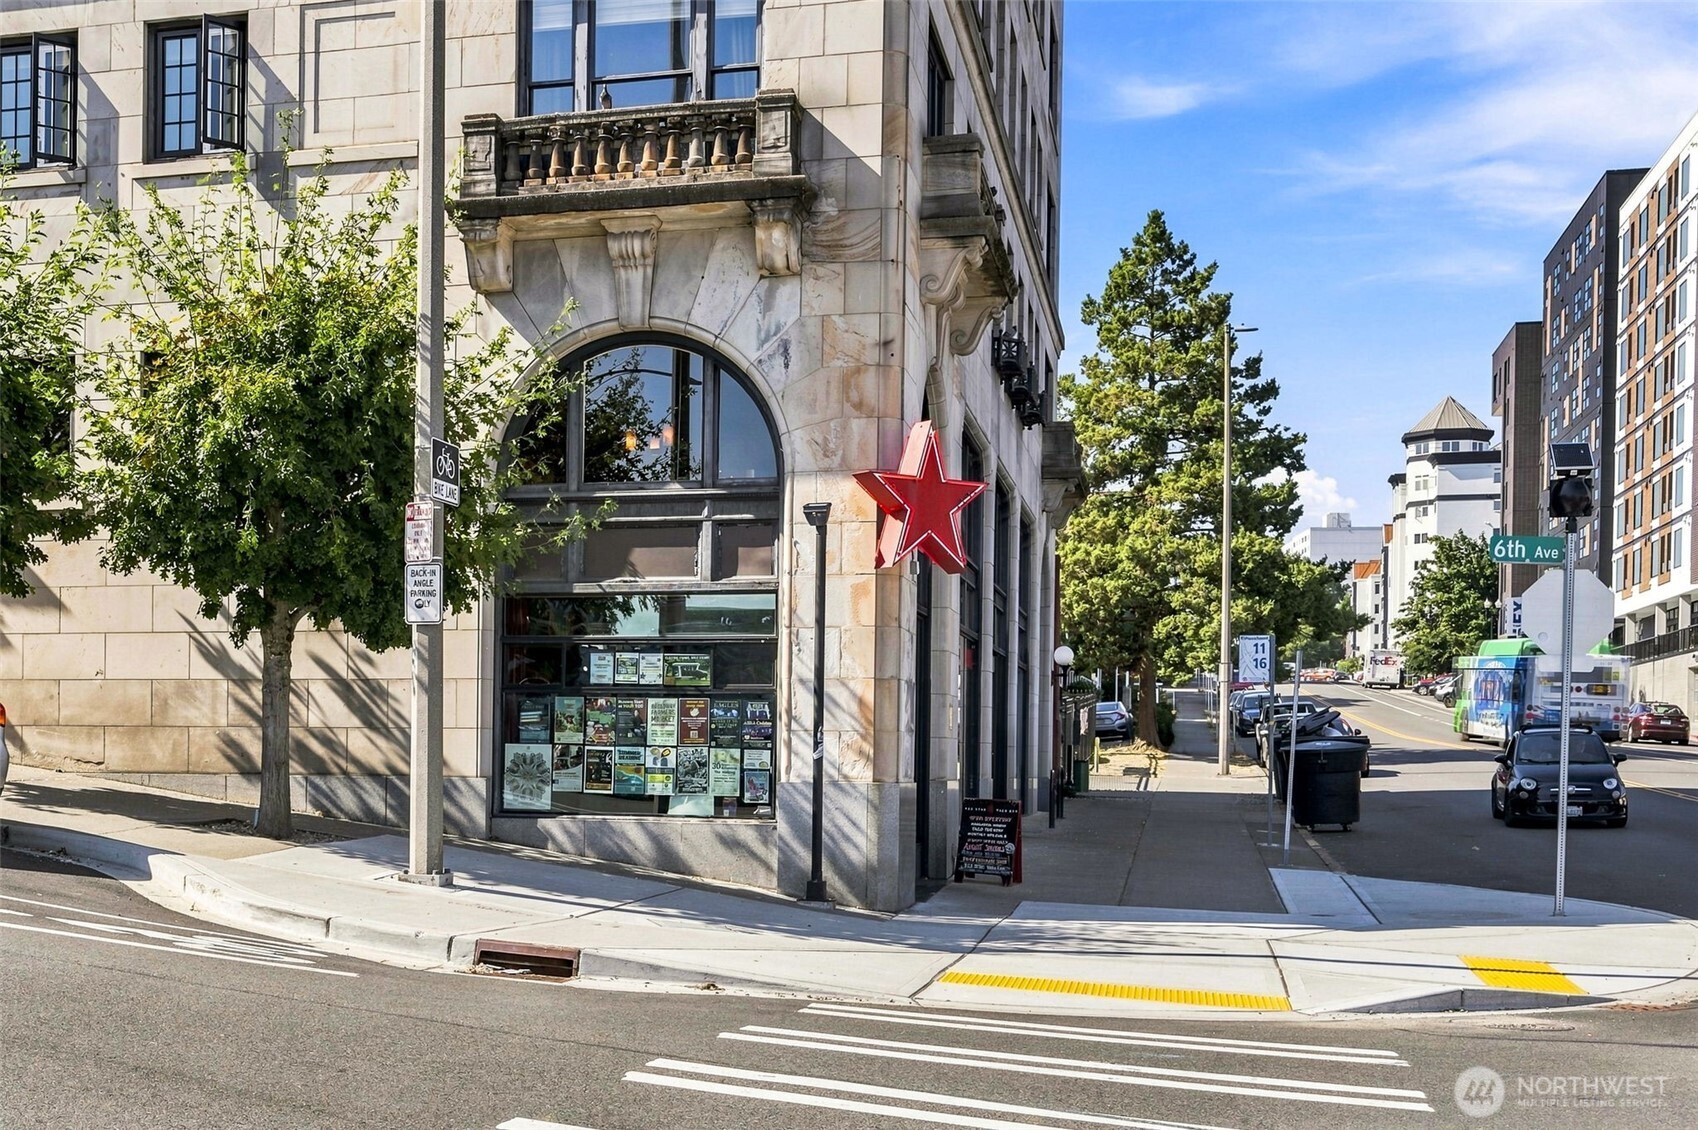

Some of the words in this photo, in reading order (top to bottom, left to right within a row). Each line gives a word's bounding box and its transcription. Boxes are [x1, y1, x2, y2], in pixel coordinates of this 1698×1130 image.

[434, 481, 445, 497] BIKE
[445, 485, 457, 500] LANE
[1494, 540, 1526, 558] 6th
[1534, 546, 1559, 559] Ave
[410, 568, 437, 578] BACK-IN
[413, 579, 434, 588] ANGLE
[410, 589, 437, 598] PARKING
[1253, 642, 1265, 655] 11
[1253, 657, 1267, 669] 16
[1370, 656, 1398, 666] FedEx
[712, 762, 721, 770] 30
